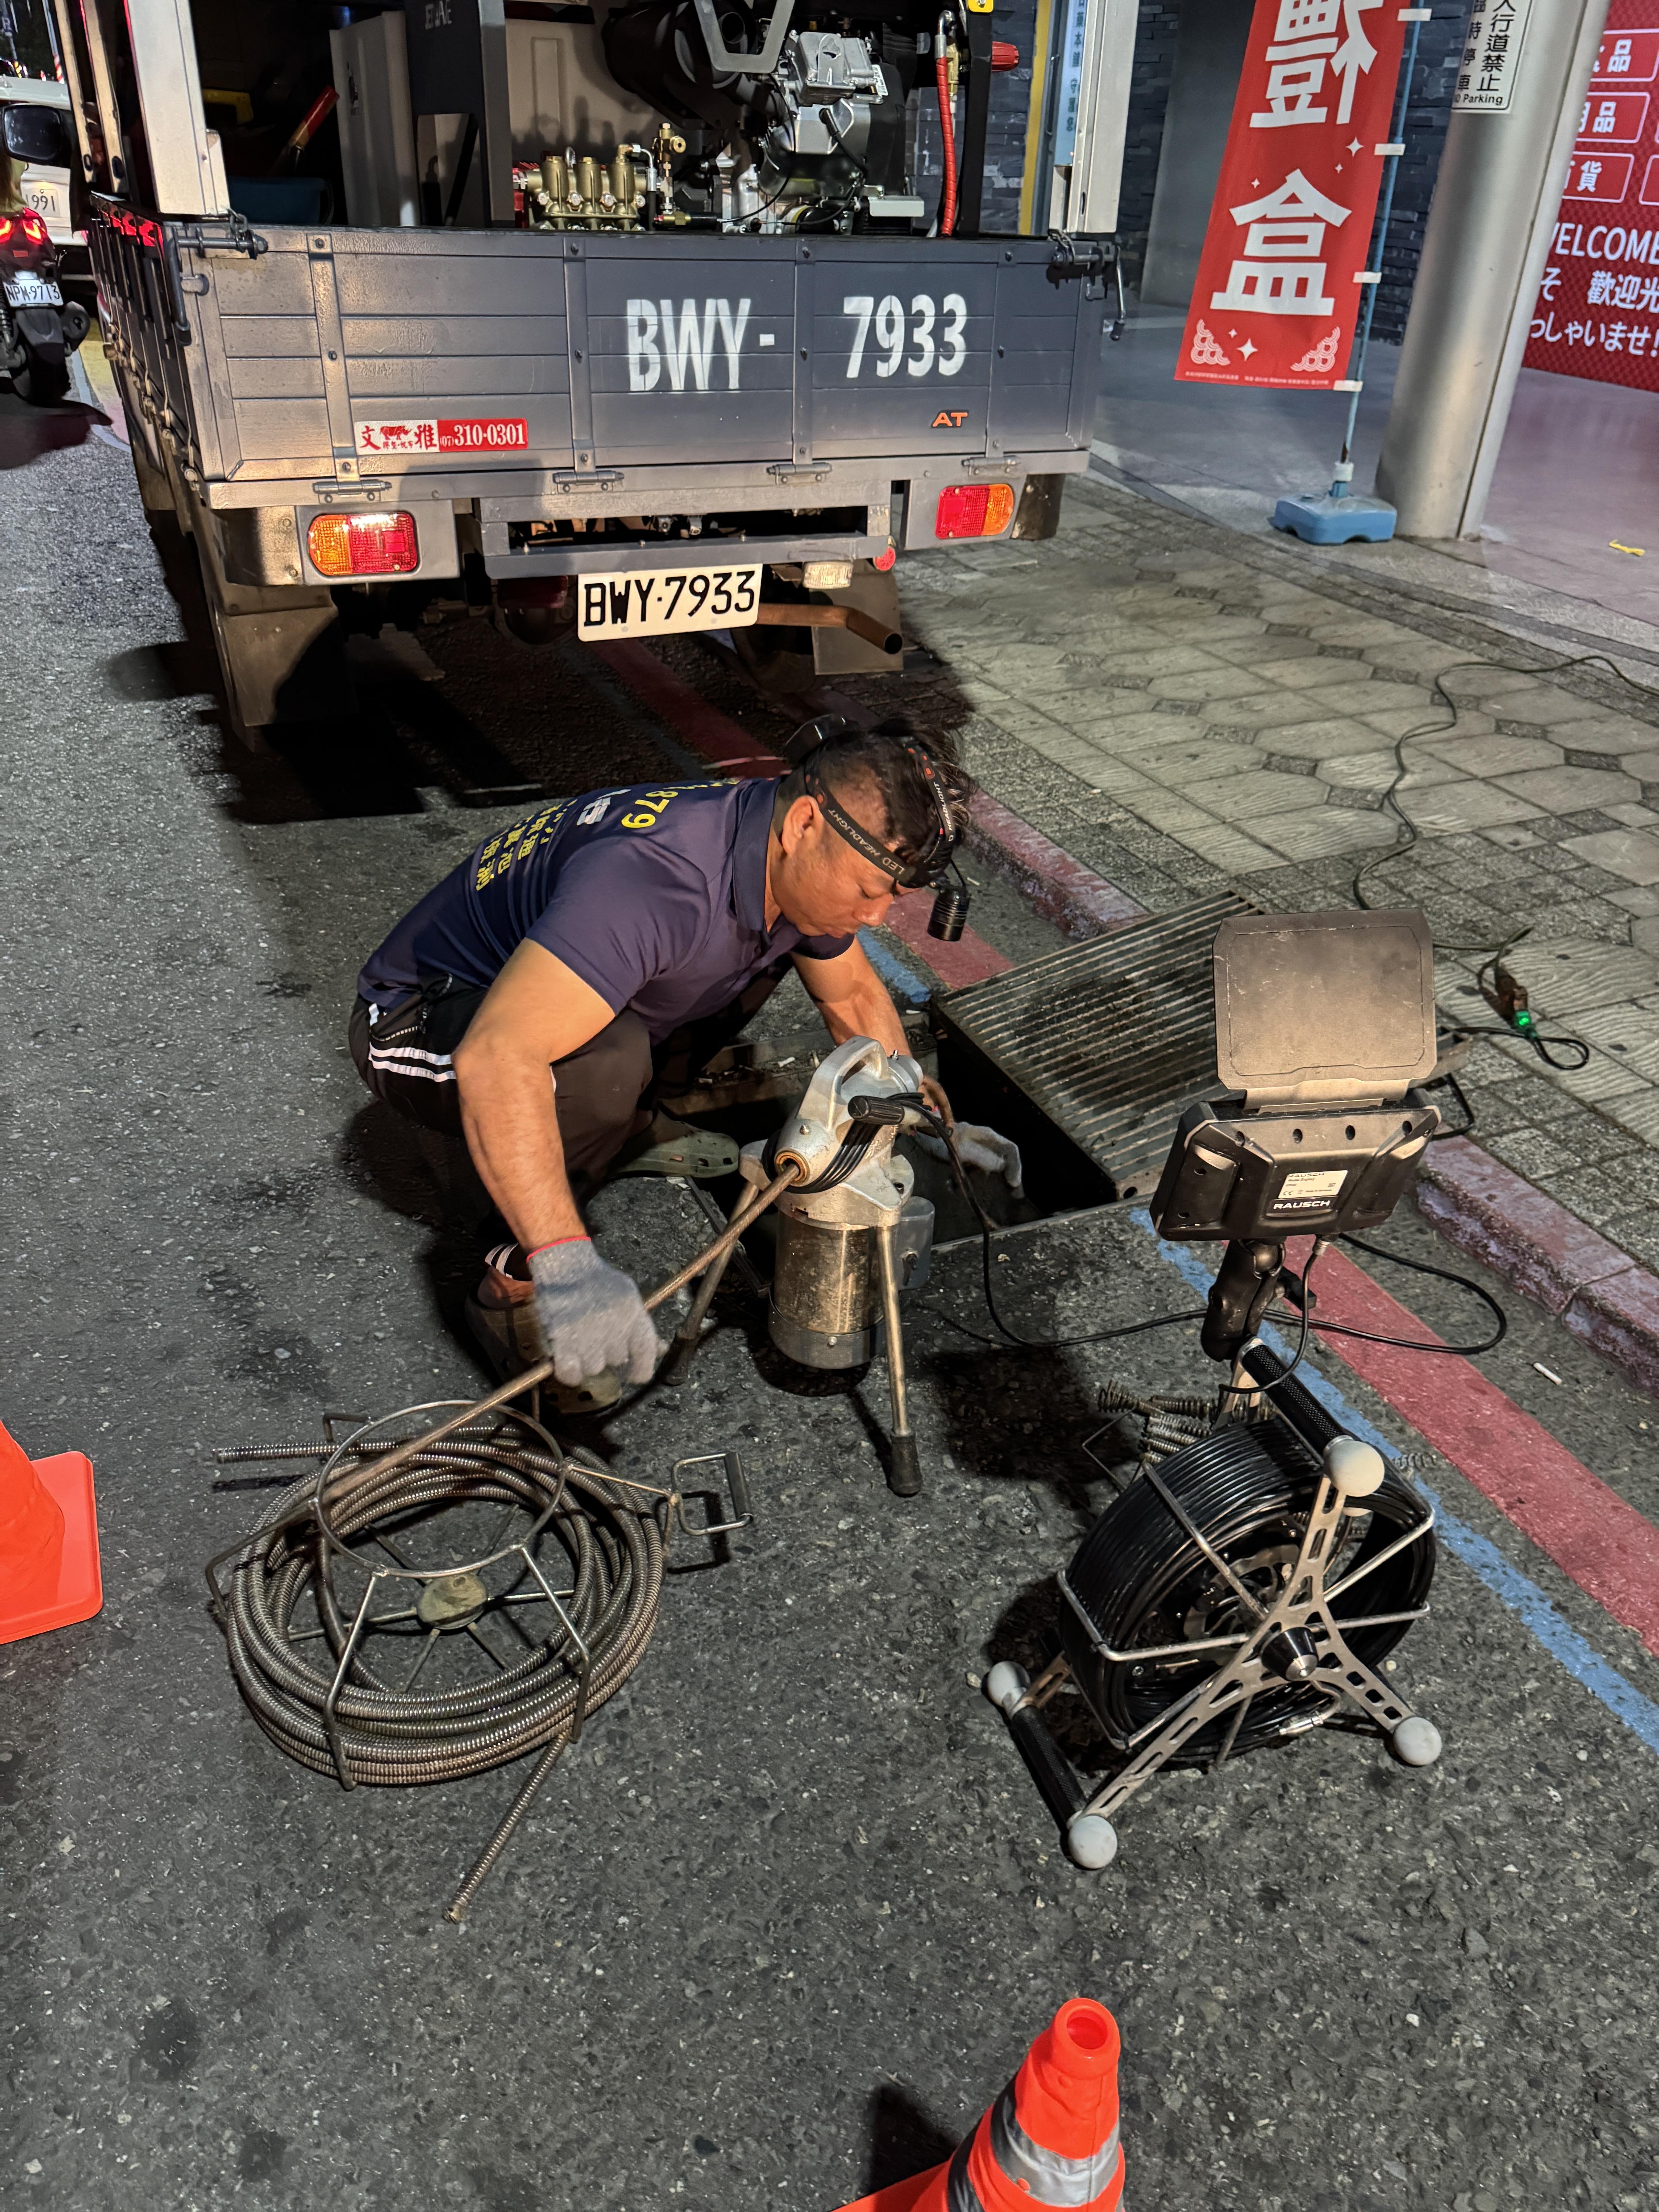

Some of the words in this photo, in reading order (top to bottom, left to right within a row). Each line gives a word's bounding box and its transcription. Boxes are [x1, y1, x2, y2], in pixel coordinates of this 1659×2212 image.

[1477, 0, 1516, 91] 人行道禁止
[1593, 39, 1632, 72] 品
[1463, 94, 1503, 106] Parking
[1564, 160, 1602, 192] 貨
[1550, 222, 1659, 265] ELCOME
[843, 293, 967, 378] 7933
[933, 412, 967, 427] AT
[933, 781, 952, 831] HEADLIGHT
[828, 809, 880, 856] HEADLIGHT
[882, 857, 905, 875] LED
[1273, 1200, 1330, 1209] RAUSCH
